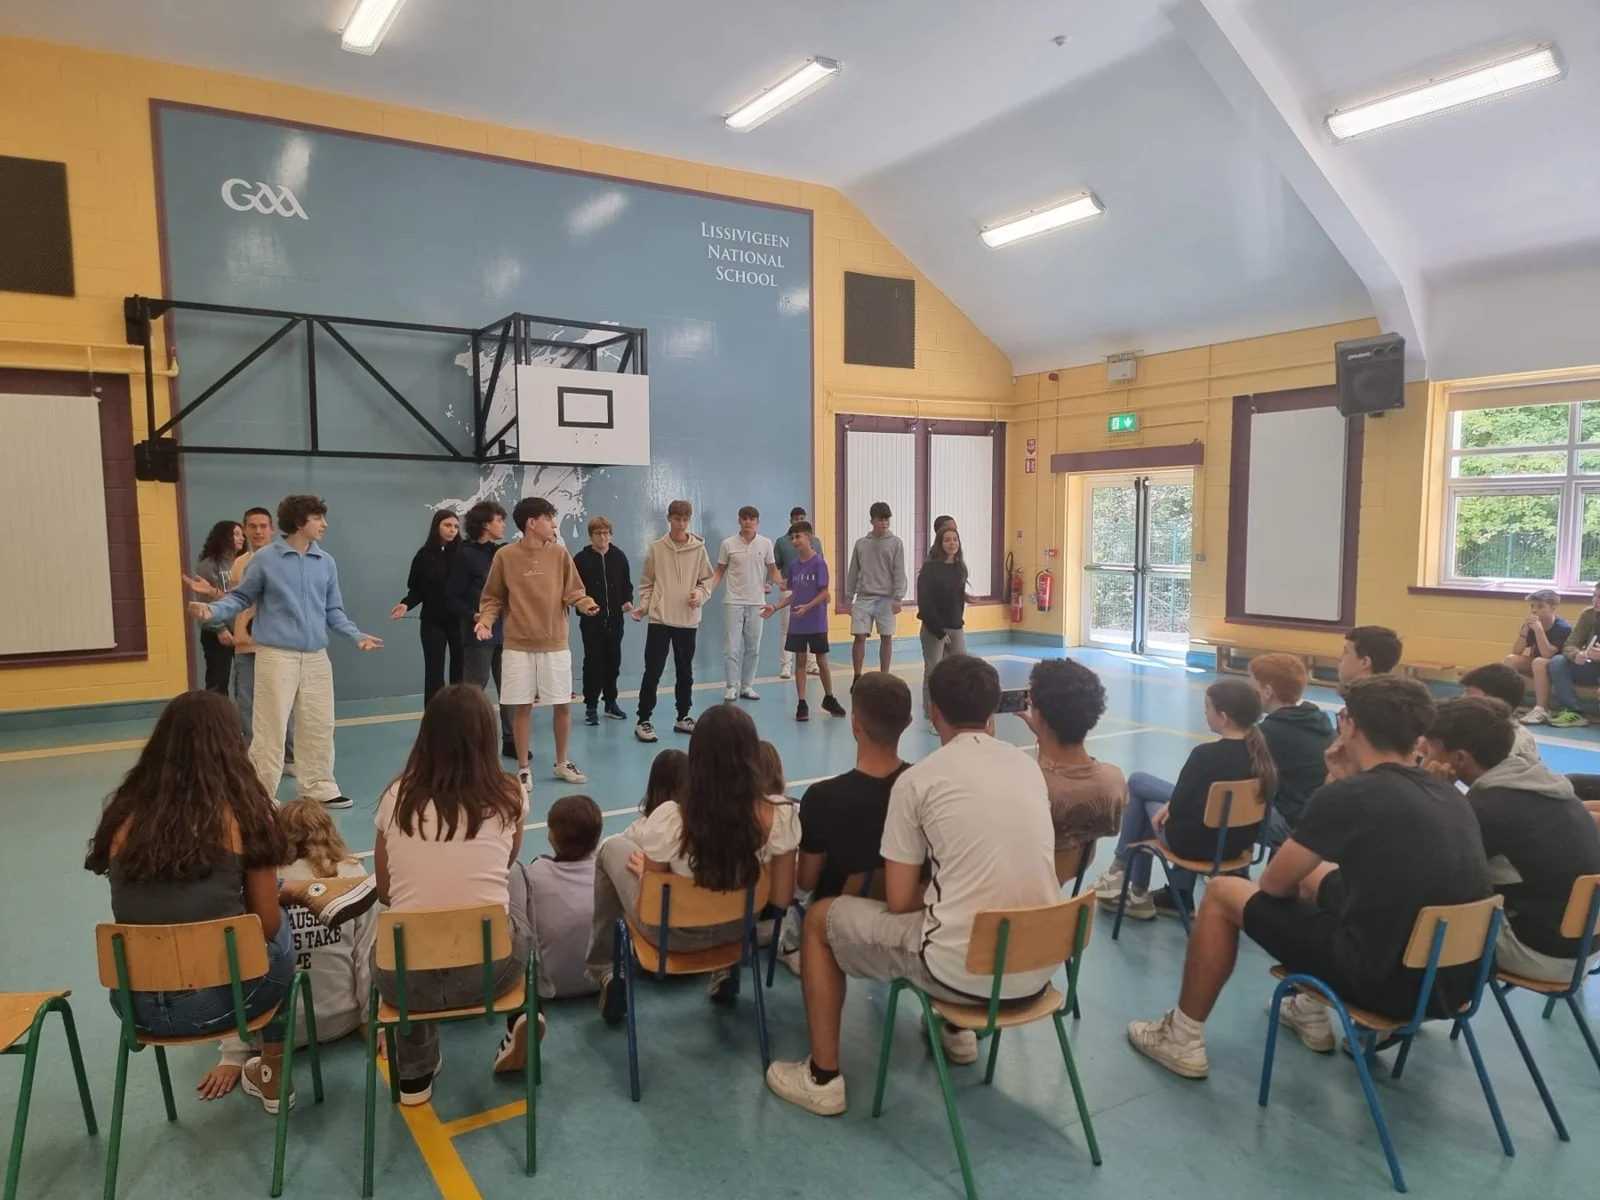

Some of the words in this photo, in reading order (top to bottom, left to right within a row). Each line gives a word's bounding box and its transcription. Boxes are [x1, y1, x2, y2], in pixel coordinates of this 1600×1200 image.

[700, 221, 790, 248] LISSIVIGEEN
[707, 243, 785, 268] NATIONAL
[715, 265, 778, 287] SCHOOL
[305, 926, 341, 948] TAKE
